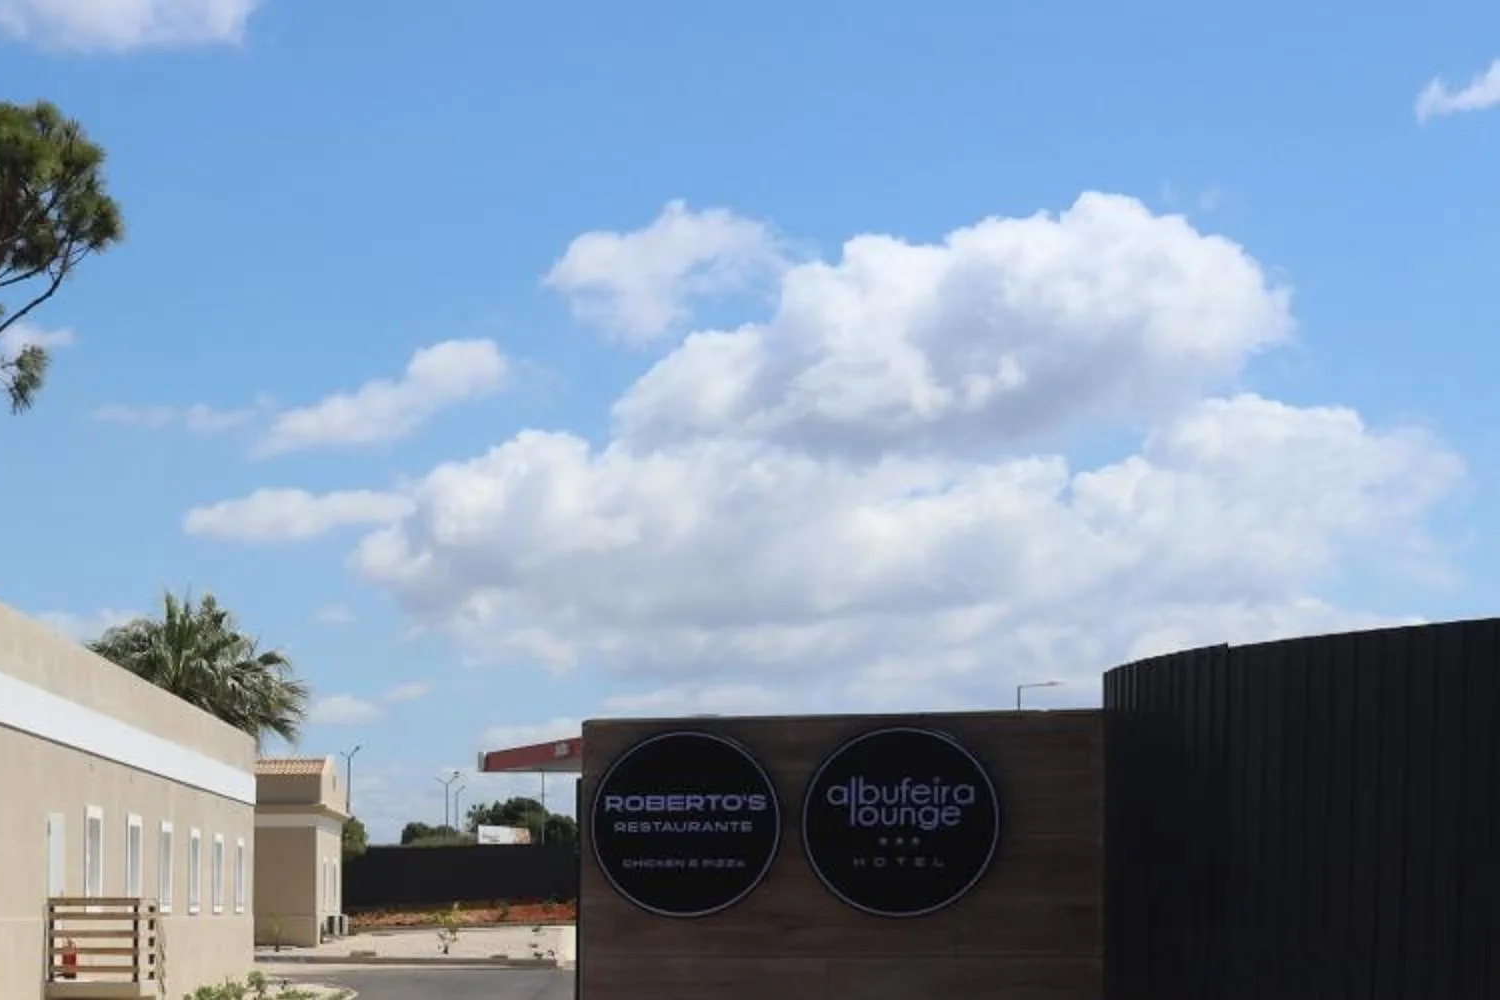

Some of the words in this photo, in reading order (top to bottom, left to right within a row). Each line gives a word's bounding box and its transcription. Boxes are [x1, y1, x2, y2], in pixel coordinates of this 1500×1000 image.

[826, 776, 975, 805] albufeira
[604, 794, 767, 812] ROBERTO'S
[850, 803, 962, 831] lounge
[614, 821, 753, 833] RESTAURANTE
[702, 858, 747, 868] PIZZA
[853, 856, 945, 867] HOTEL
